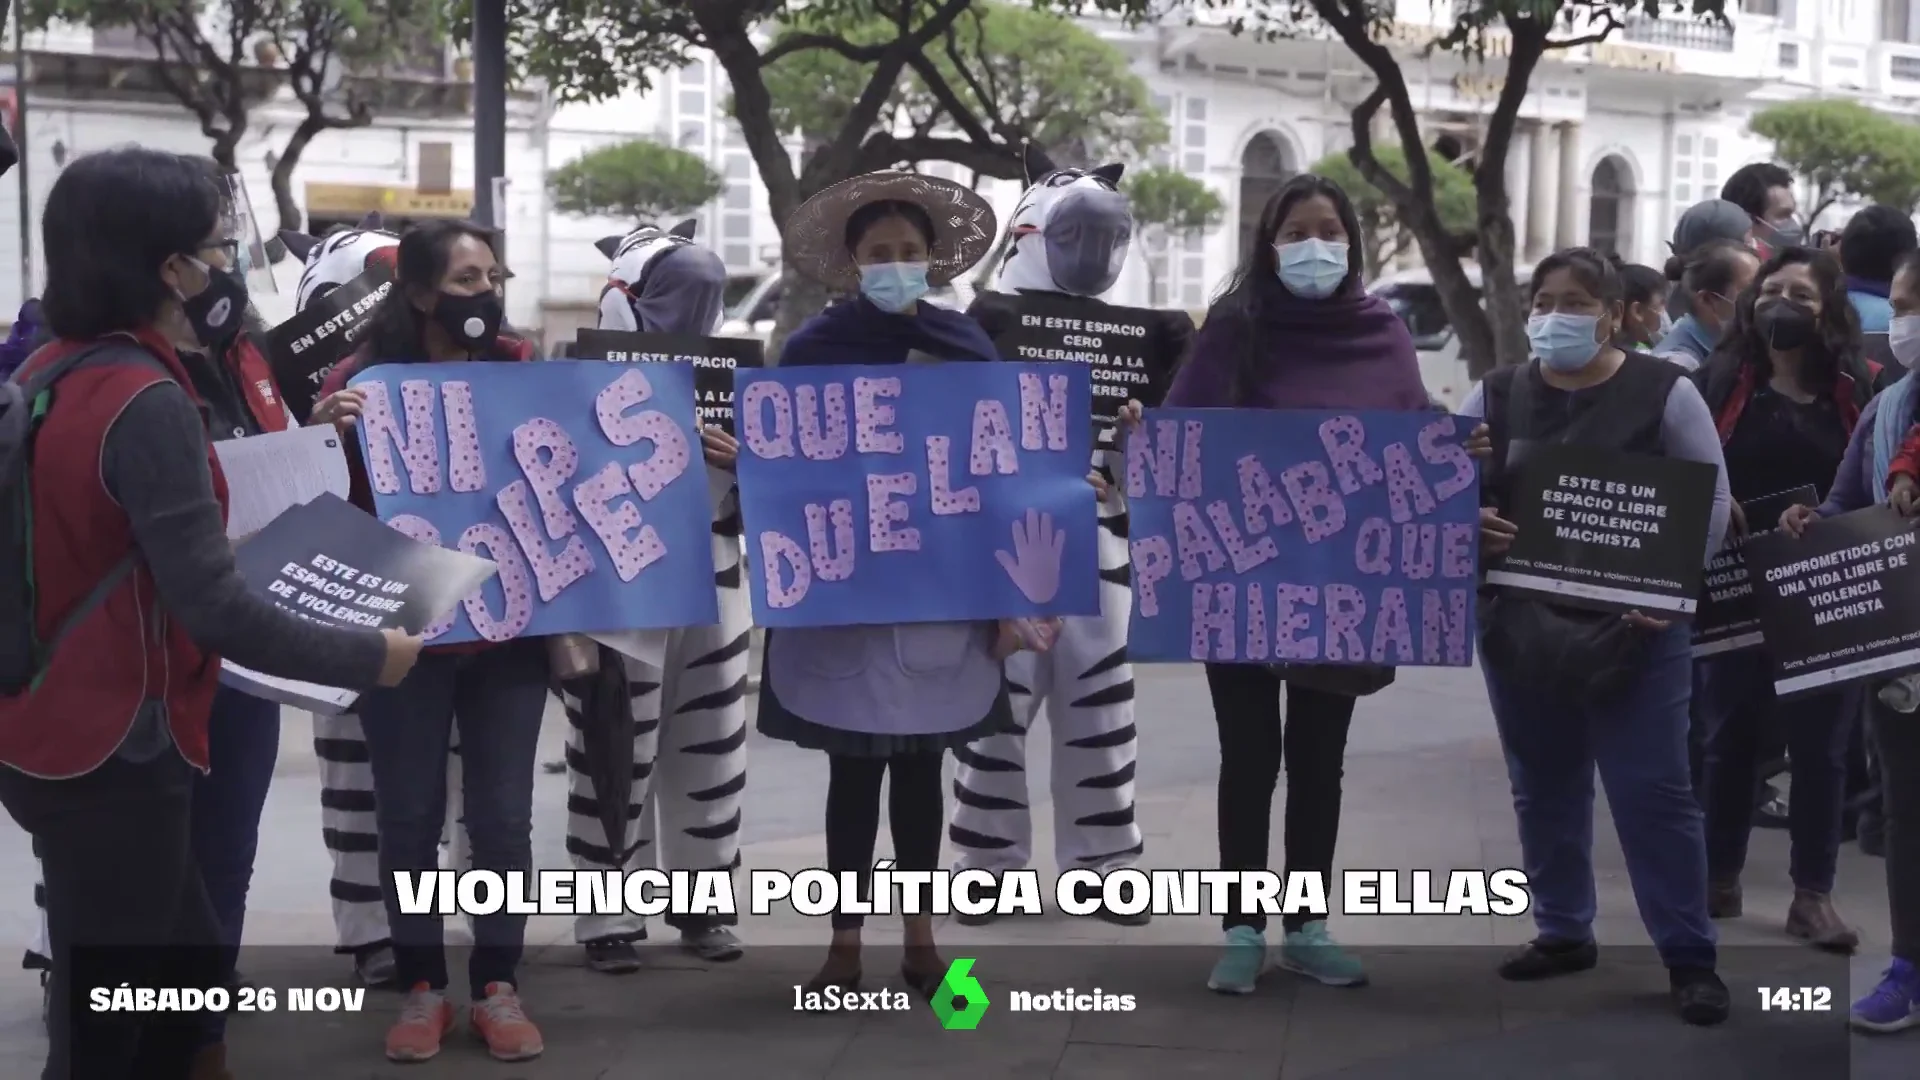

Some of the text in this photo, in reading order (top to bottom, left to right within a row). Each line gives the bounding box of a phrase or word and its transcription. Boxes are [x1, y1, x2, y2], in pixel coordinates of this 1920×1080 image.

[290, 334, 315, 355] EN
[315, 309, 355, 340] ESTE
[1022, 315, 1146, 337] EN ESTE ESPACIO
[1063, 335, 1103, 349] CERO
[607, 351, 627, 363] EN
[1018, 346, 1145, 369] TOLERANCIA A LA
[1091, 368, 1150, 385] CONTRA
[1090, 384, 1129, 399] ERES
[357, 379, 488, 496] NI
[743, 376, 904, 461] QUE
[1126, 418, 1204, 500] NI
[759, 372, 1069, 609] DUELAN
[1542, 489, 1668, 518] ESPACIO LIBRE
[1558, 475, 1656, 499] ESTE ES UN
[1130, 414, 1476, 618] PALABRAS
[1543, 507, 1660, 534] DE VIOLENCIA
[1355, 516, 1474, 580] QUE
[1555, 526, 1641, 549] MACHISTA
[1765, 541, 1881, 582] COMPROMETIDOS
[1884, 532, 1916, 551] CON
[281, 561, 405, 612] ESPACIO LIBRE
[311, 553, 409, 594] ESTE ES UN
[1778, 552, 1908, 597] UNA VIDA LIBRE DE
[1808, 579, 1883, 608] VIOLENCIA
[268, 578, 298, 599] DE
[297, 591, 383, 628] VIOLENCIA
[1814, 597, 1885, 627] MACHISTA
[1190, 582, 1469, 666] HIERAN
